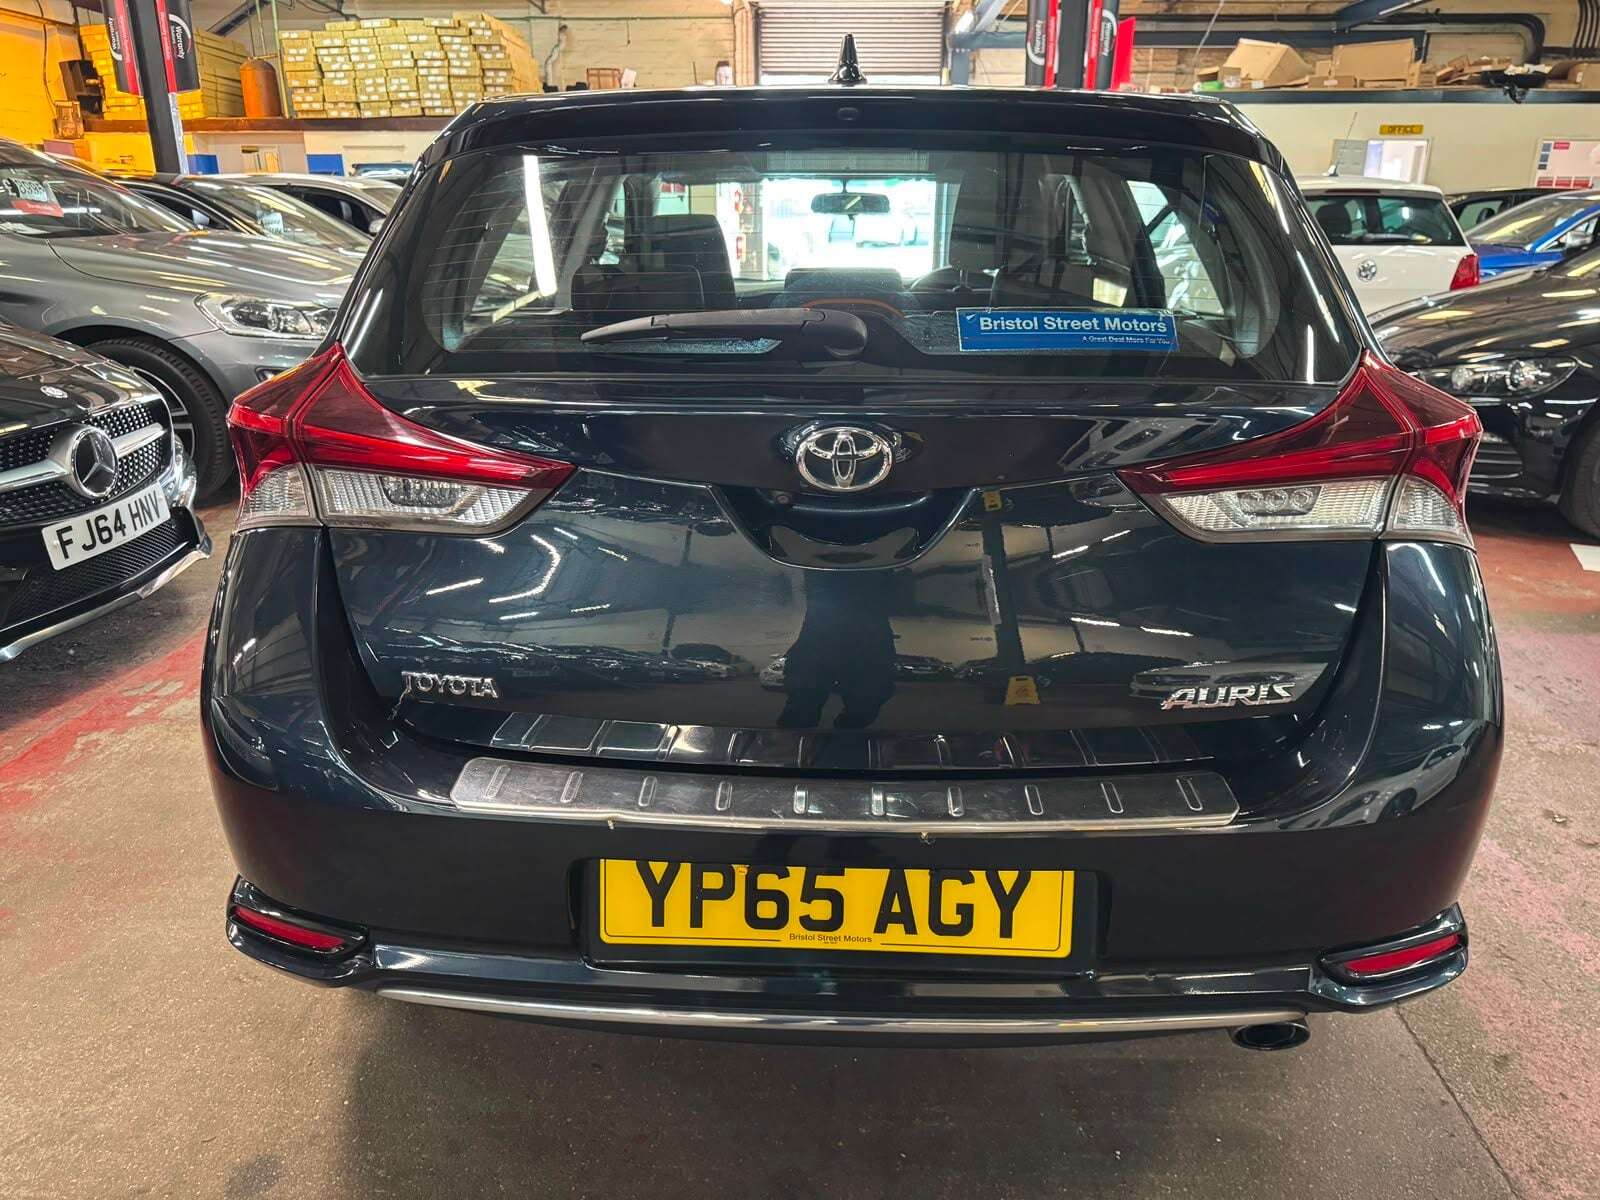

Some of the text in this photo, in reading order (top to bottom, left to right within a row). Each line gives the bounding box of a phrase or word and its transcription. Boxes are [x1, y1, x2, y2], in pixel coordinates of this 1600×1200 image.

[175, 26, 185, 59] Warranty
[1033, 20, 1043, 54] Warranty
[980, 316, 1168, 332] Bristol Street Motors
[1089, 335, 1107, 343] Great
[55, 490, 161, 560] FJ64 HNV
[401, 670, 498, 698] TOYOTA
[1160, 682, 1296, 710] AURIS
[635, 860, 1032, 939] YP65 AGY
[789, 932, 815, 941] Bristol
[816, 934, 841, 942] Street
[843, 935, 873, 943] Motors
